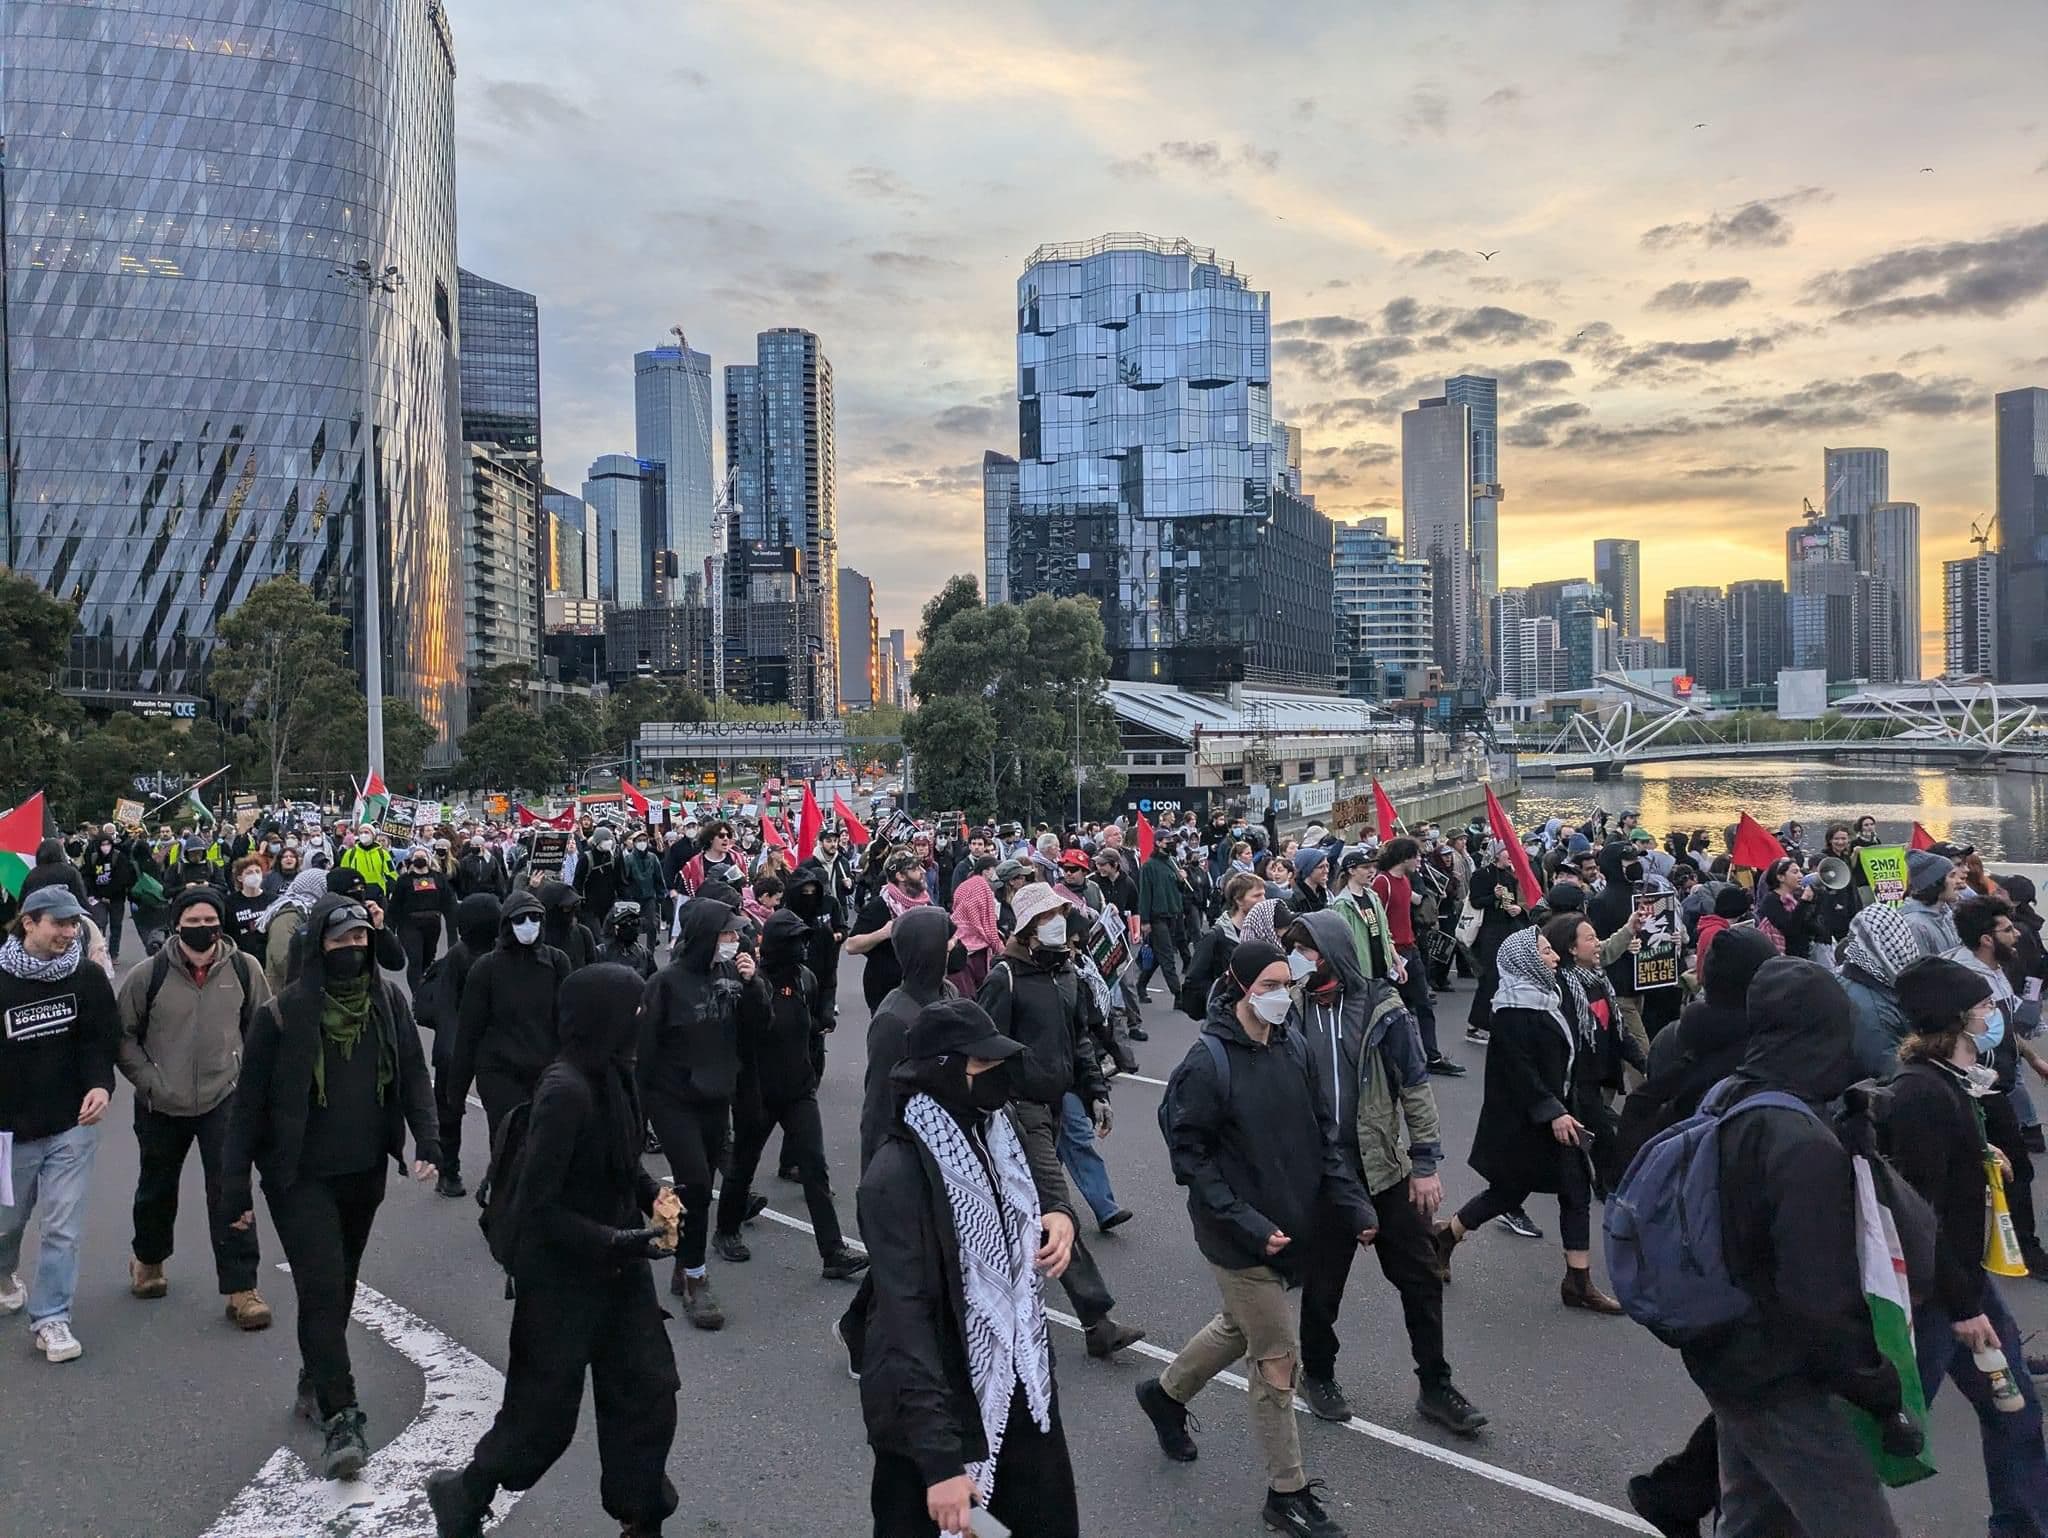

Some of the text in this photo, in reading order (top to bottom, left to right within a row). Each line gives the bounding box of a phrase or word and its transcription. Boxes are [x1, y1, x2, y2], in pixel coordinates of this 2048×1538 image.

[1153, 801, 1181, 811] ICON
[1639, 943, 1674, 960] PALESTINE
[1638, 959, 1675, 973] END THE
[1638, 969, 1675, 984] SIEGE
[14, 1002, 66, 1018] VICTORIAN
[15, 1007, 73, 1025] SOCIALISTS
